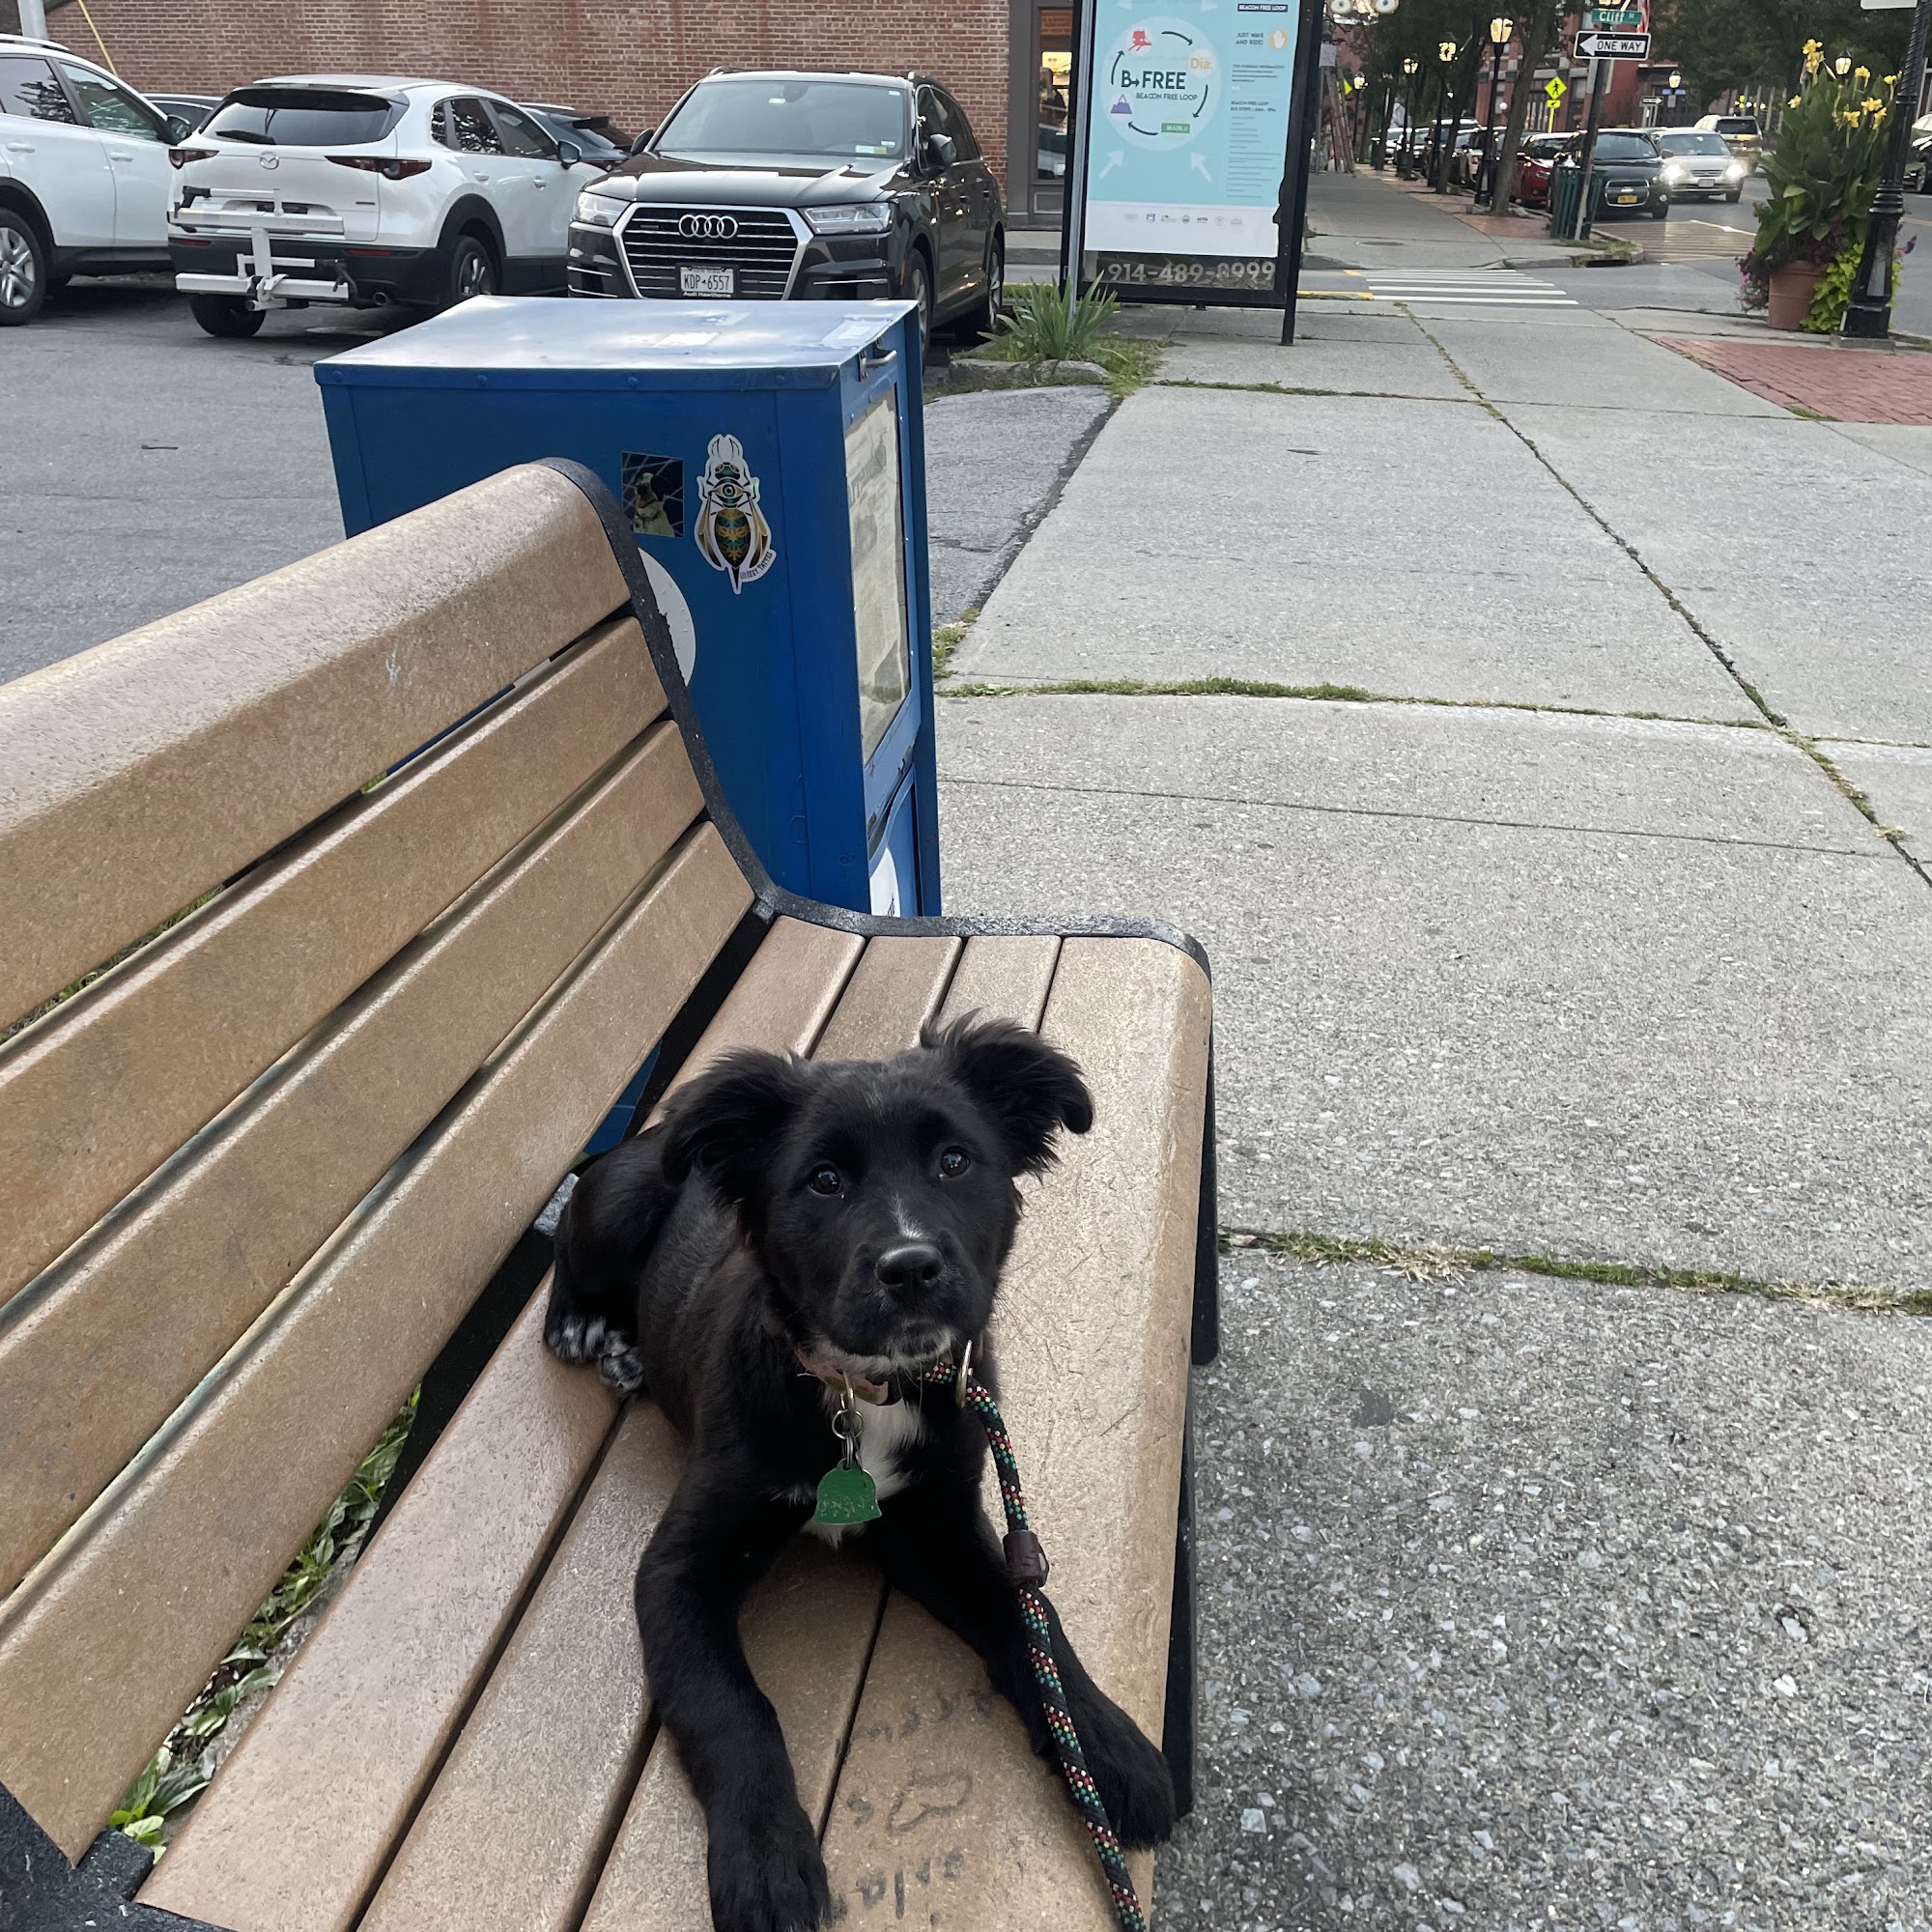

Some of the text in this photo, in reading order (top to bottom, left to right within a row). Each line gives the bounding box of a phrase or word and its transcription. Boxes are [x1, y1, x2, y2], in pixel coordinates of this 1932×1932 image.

[1599, 11, 1625, 22] Cliff
[1597, 40, 1642, 51] ONE WAY
[1142, 71, 1187, 90] FREE
